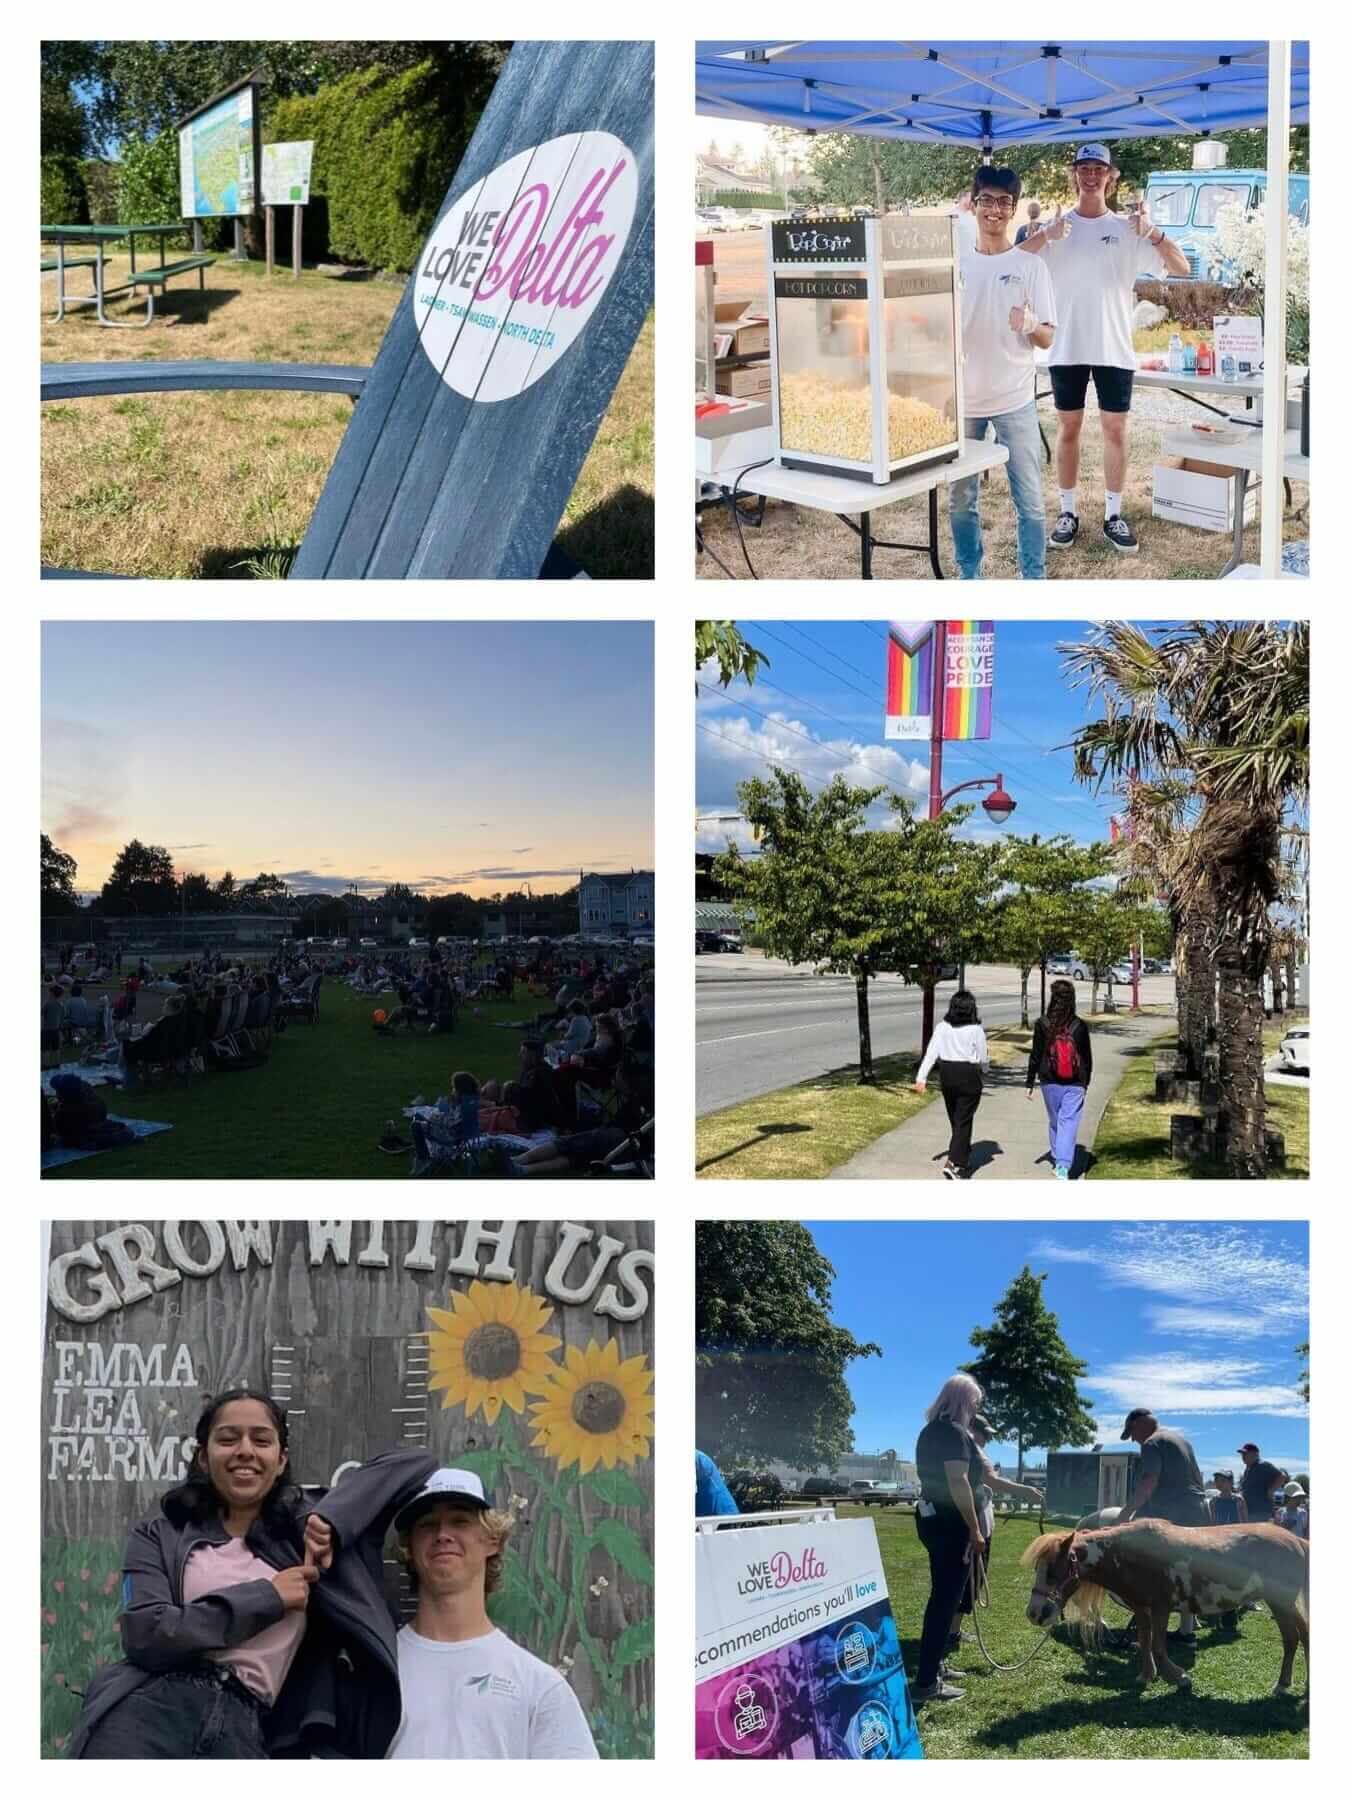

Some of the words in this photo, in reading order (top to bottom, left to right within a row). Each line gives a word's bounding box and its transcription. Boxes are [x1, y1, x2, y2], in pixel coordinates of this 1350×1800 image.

[458, 210, 501, 248] WE
[473, 159, 626, 309] Delta
[422, 246, 483, 289] LOVE
[946, 671, 993, 685] PRIDE
[947, 655, 993, 670] LOVE
[545, 1221, 655, 1322] US
[54, 1341, 199, 1387] EMMA
[50, 1387, 148, 1435] LEA
[48, 1435, 199, 1482] FARMS
[737, 1575, 773, 1596] LOVE
[746, 1560, 770, 1578] WE
[770, 1547, 828, 1590] Delta
[823, 1586, 854, 1617] you'll
[855, 1581, 878, 1599] love
